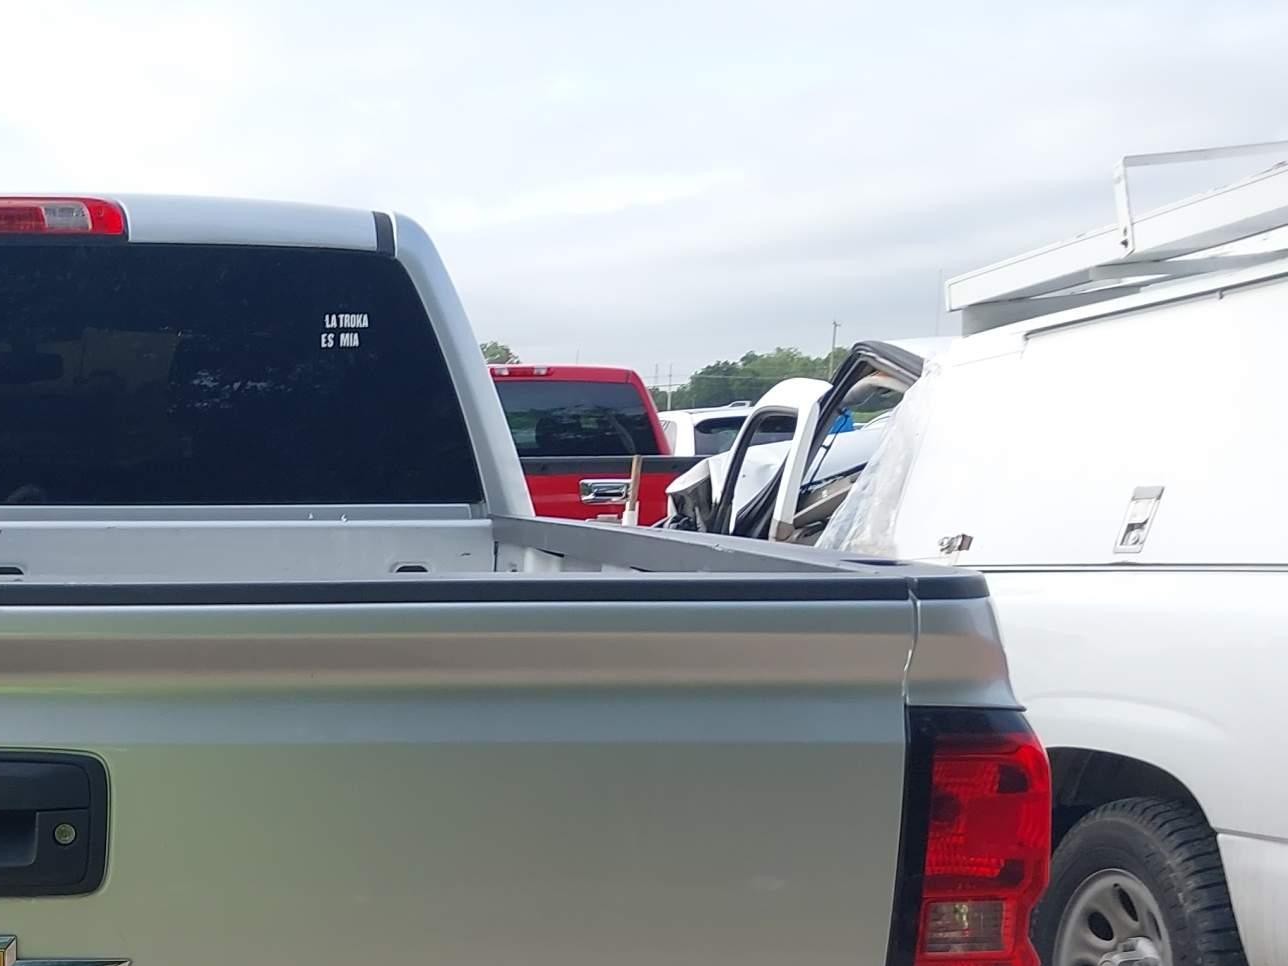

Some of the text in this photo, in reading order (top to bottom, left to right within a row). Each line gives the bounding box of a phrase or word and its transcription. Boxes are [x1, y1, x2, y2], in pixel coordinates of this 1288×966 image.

[324, 313, 369, 328] LA TROKA
[321, 332, 360, 348] ES MIA
